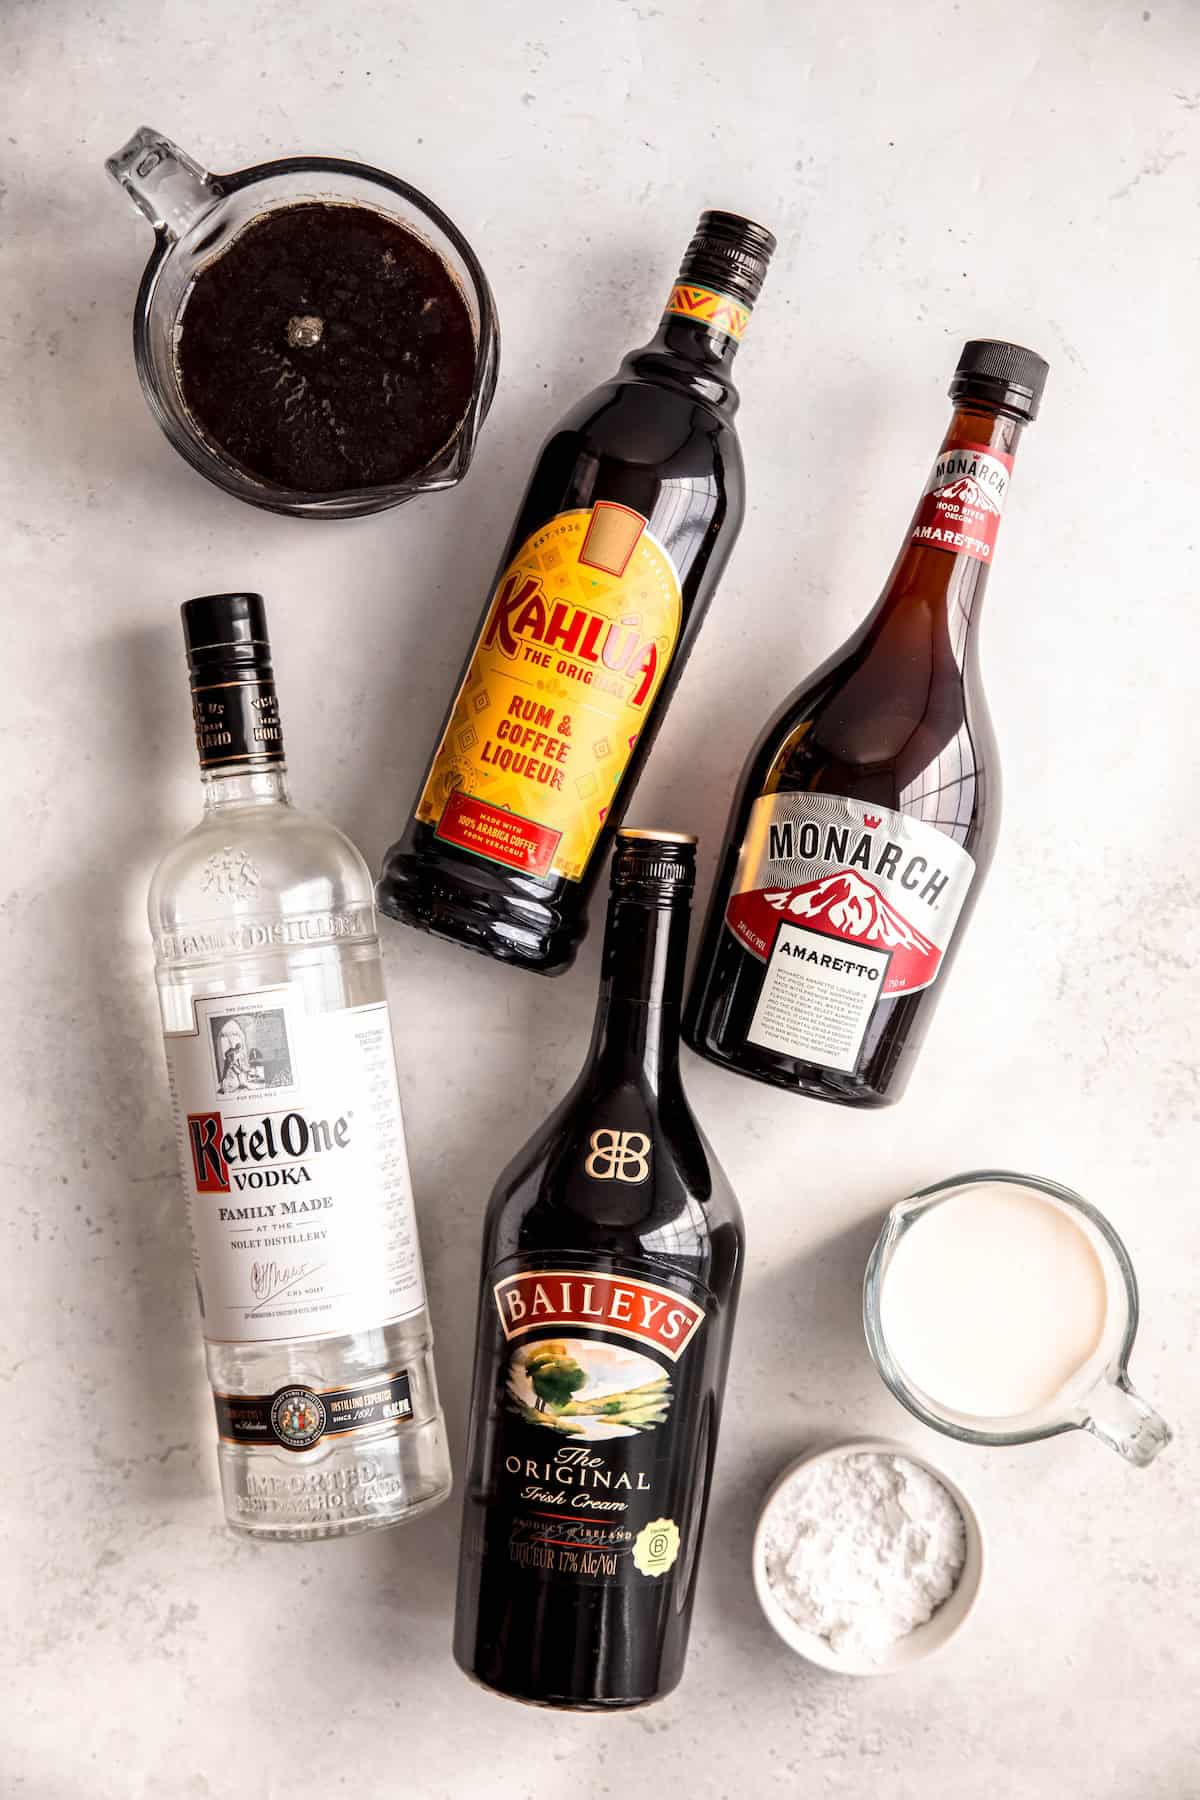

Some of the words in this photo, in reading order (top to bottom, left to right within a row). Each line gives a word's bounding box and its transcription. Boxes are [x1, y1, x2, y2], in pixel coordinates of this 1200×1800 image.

[936, 459, 1005, 494] MONARCH
[912, 526, 991, 556] AMARETTO
[523, 647, 553, 668] THE
[508, 694, 555, 729] RUM
[557, 715, 572, 736] &
[496, 719, 571, 764] COFFEE
[480, 740, 565, 791] LIQUEUR
[476, 822, 510, 844] ARABICA
[510, 834, 540, 854] COFFEE
[768, 822, 950, 908] MONARCH
[778, 941, 880, 982] AMARETTO
[190, 1116, 278, 1186] Ketel
[280, 1112, 352, 1158] One
[233, 1166, 312, 1191] VODKA
[218, 1204, 276, 1221] FAMILY
[281, 1196, 334, 1216] MADE
[231, 1239, 262, 1250] NOLET
[264, 1230, 328, 1248] DISTILLERY
[256, 1224, 268, 1233] AT
[272, 1221, 292, 1231] THE
[505, 1282, 690, 1341] BAILEYS
[505, 1456, 651, 1490] ORIGINAL
[554, 1447, 605, 1468] The
[520, 1486, 567, 1506] Irish
[571, 1494, 628, 1511] Cream
[580, 1529, 632, 1540] IRELAND
[510, 1543, 555, 1569] LIQUEUR
[558, 1552, 578, 1573] 17%
[580, 1552, 618, 1577] Alc/Vol
